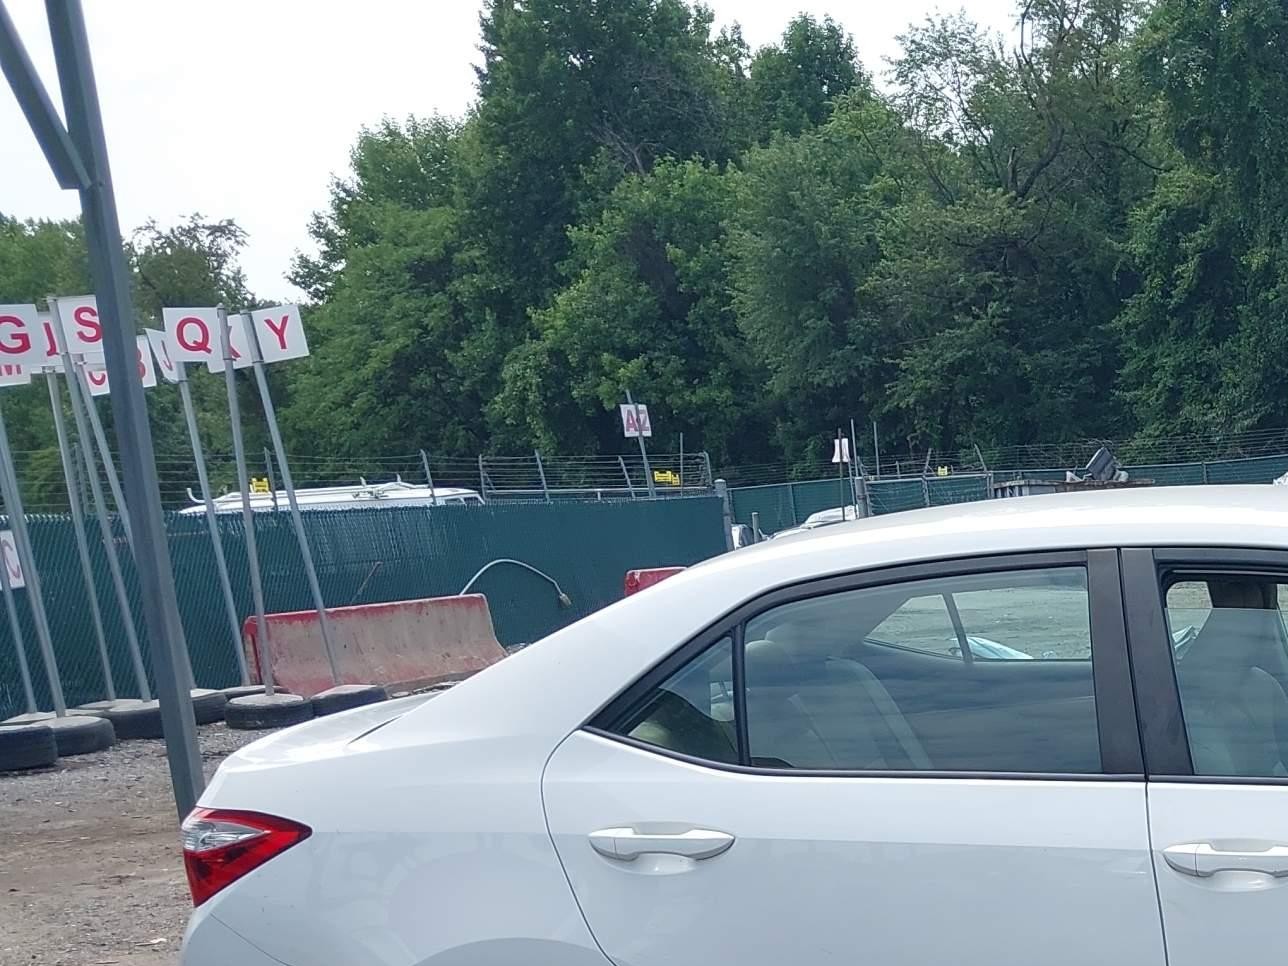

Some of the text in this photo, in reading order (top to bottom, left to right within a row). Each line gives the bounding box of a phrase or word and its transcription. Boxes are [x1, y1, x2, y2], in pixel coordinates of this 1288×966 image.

[74, 306, 103, 343] S
[176, 317, 212, 354] Q
[264, 315, 289, 350] Y
